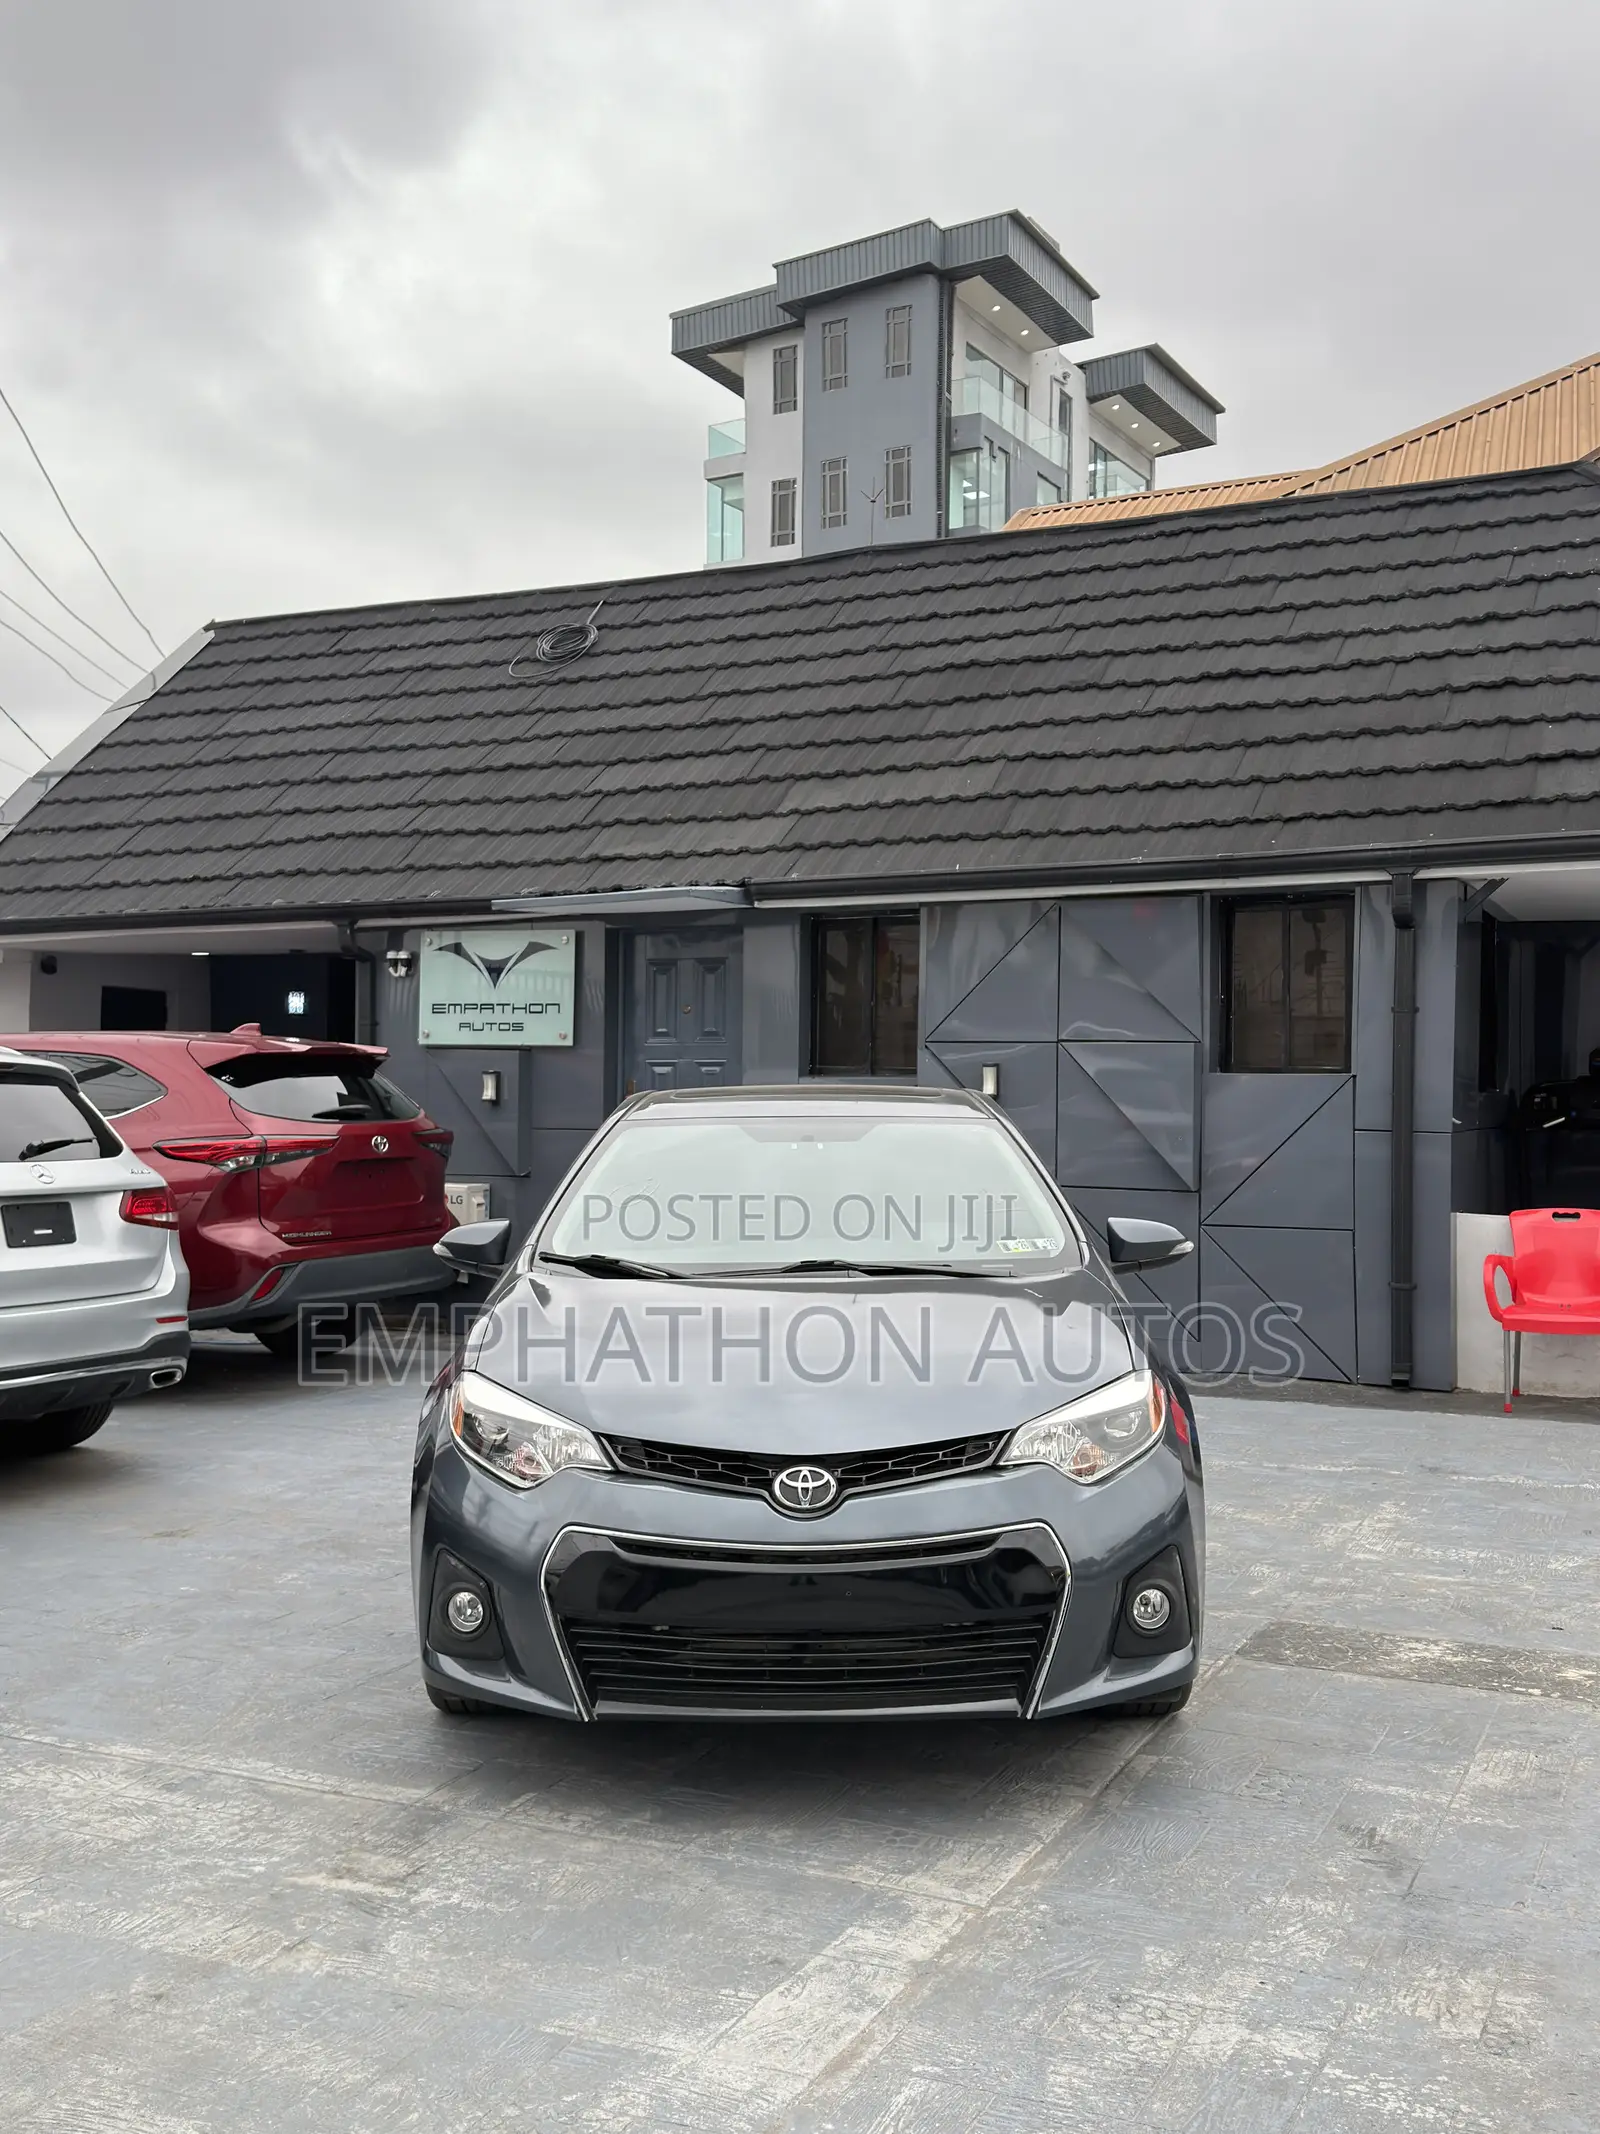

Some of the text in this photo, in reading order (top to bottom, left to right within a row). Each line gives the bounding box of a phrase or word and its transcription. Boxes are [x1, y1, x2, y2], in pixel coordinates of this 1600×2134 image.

[431, 1003, 561, 1014] EMPATHON
[458, 1022, 525, 1032] AUTOS
[450, 1195, 463, 1205] LG
